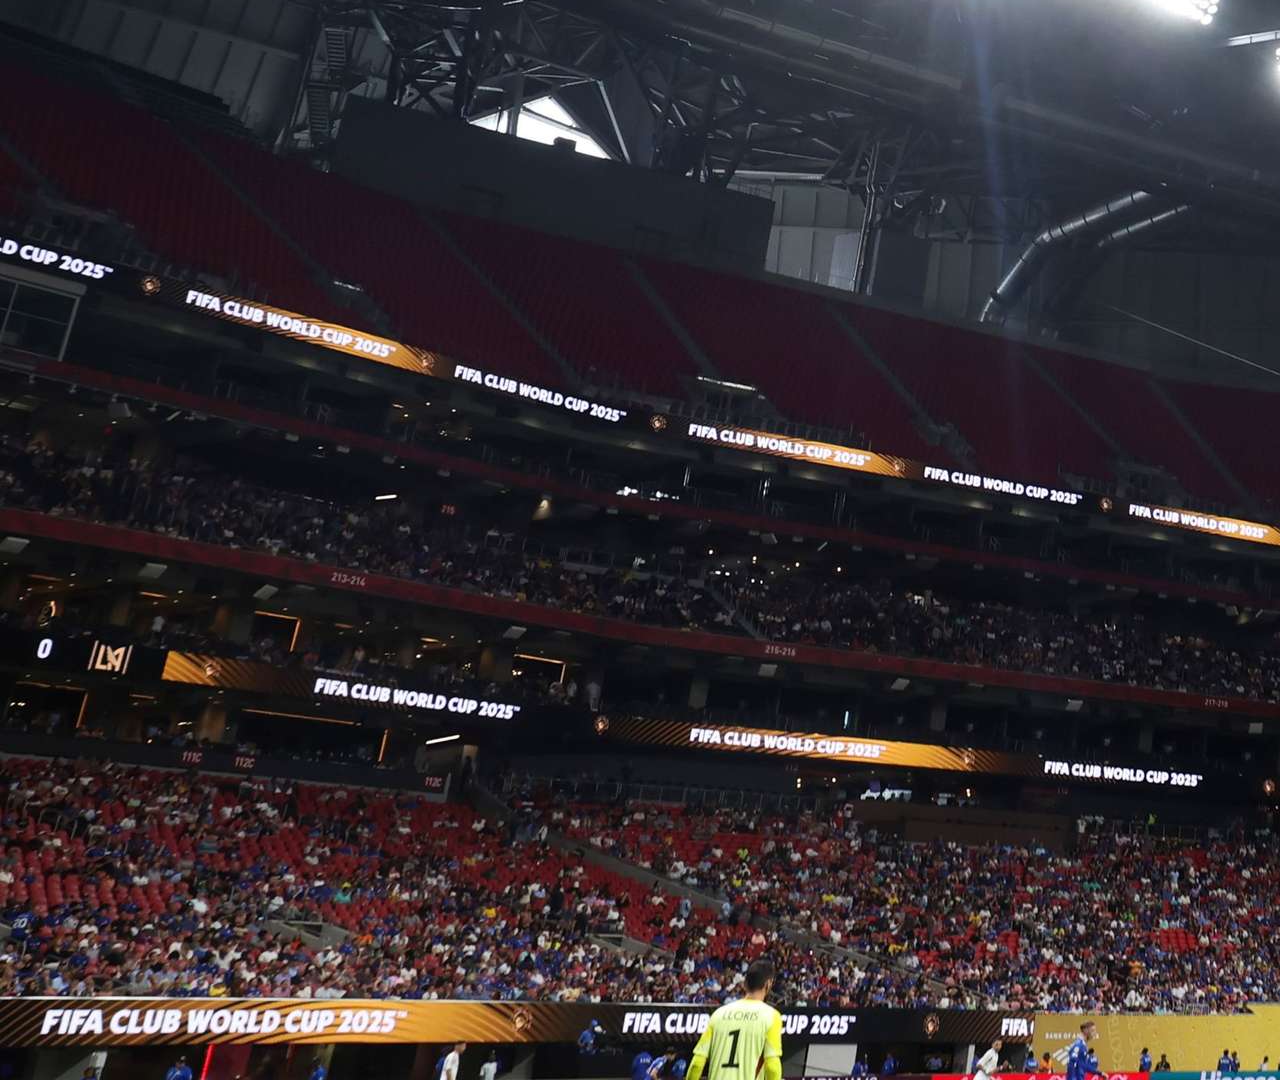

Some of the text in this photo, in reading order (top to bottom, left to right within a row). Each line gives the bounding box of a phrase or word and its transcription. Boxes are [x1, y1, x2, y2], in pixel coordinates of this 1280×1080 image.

[20, 245, 58, 265] CUP
[186, 290, 221, 311] FIFA
[223, 300, 264, 323] CLUB
[266, 312, 321, 338] WORLD
[323, 327, 353, 346] CUP
[454, 365, 482, 384] FIFA
[484, 374, 517, 393] CLUB
[519, 383, 563, 406] WORLD
[564, 396, 589, 412] CUP
[688, 423, 718, 440] FIFA
[720, 430, 754, 446] CLUB
[756, 437, 804, 454] WORLD
[806, 445, 831, 460] CUP
[924, 466, 950, 481] FIFA
[951, 471, 981, 487] CLUB
[983, 477, 1024, 495] WORLD
[1025, 485, 1049, 499] CUP
[1129, 504, 1151, 519] FIFA
[1152, 509, 1180, 524] CLUB
[1181, 513, 1217, 529] WORLD
[1218, 521, 1238, 534] CUP
[37, 638, 53, 660] 0
[314, 678, 349, 697] FIFA
[351, 683, 390, 703] CLUB
[392, 689, 447, 711] WORLD
[448, 697, 478, 714] CUP
[690, 728, 721, 744] FIFA
[723, 731, 761, 748] CLUB
[763, 735, 814, 752] WORLD
[816, 739, 846, 754] CUP
[1044, 761, 1070, 776] FIFA
[1071, 763, 1102, 778] CLUB
[1103, 766, 1145, 782] WORLD
[1145, 771, 1169, 784] CUP
[40, 1009, 103, 1035] FIFA
[110, 1010, 180, 1034] CLUB
[187, 1010, 280, 1034] WORLD
[283, 1010, 335, 1034] CUP
[622, 1012, 710, 1034] FIFA CLUB
[1001, 1018, 1029, 1038] FIFA
[721, 1030, 743, 1068] 1
